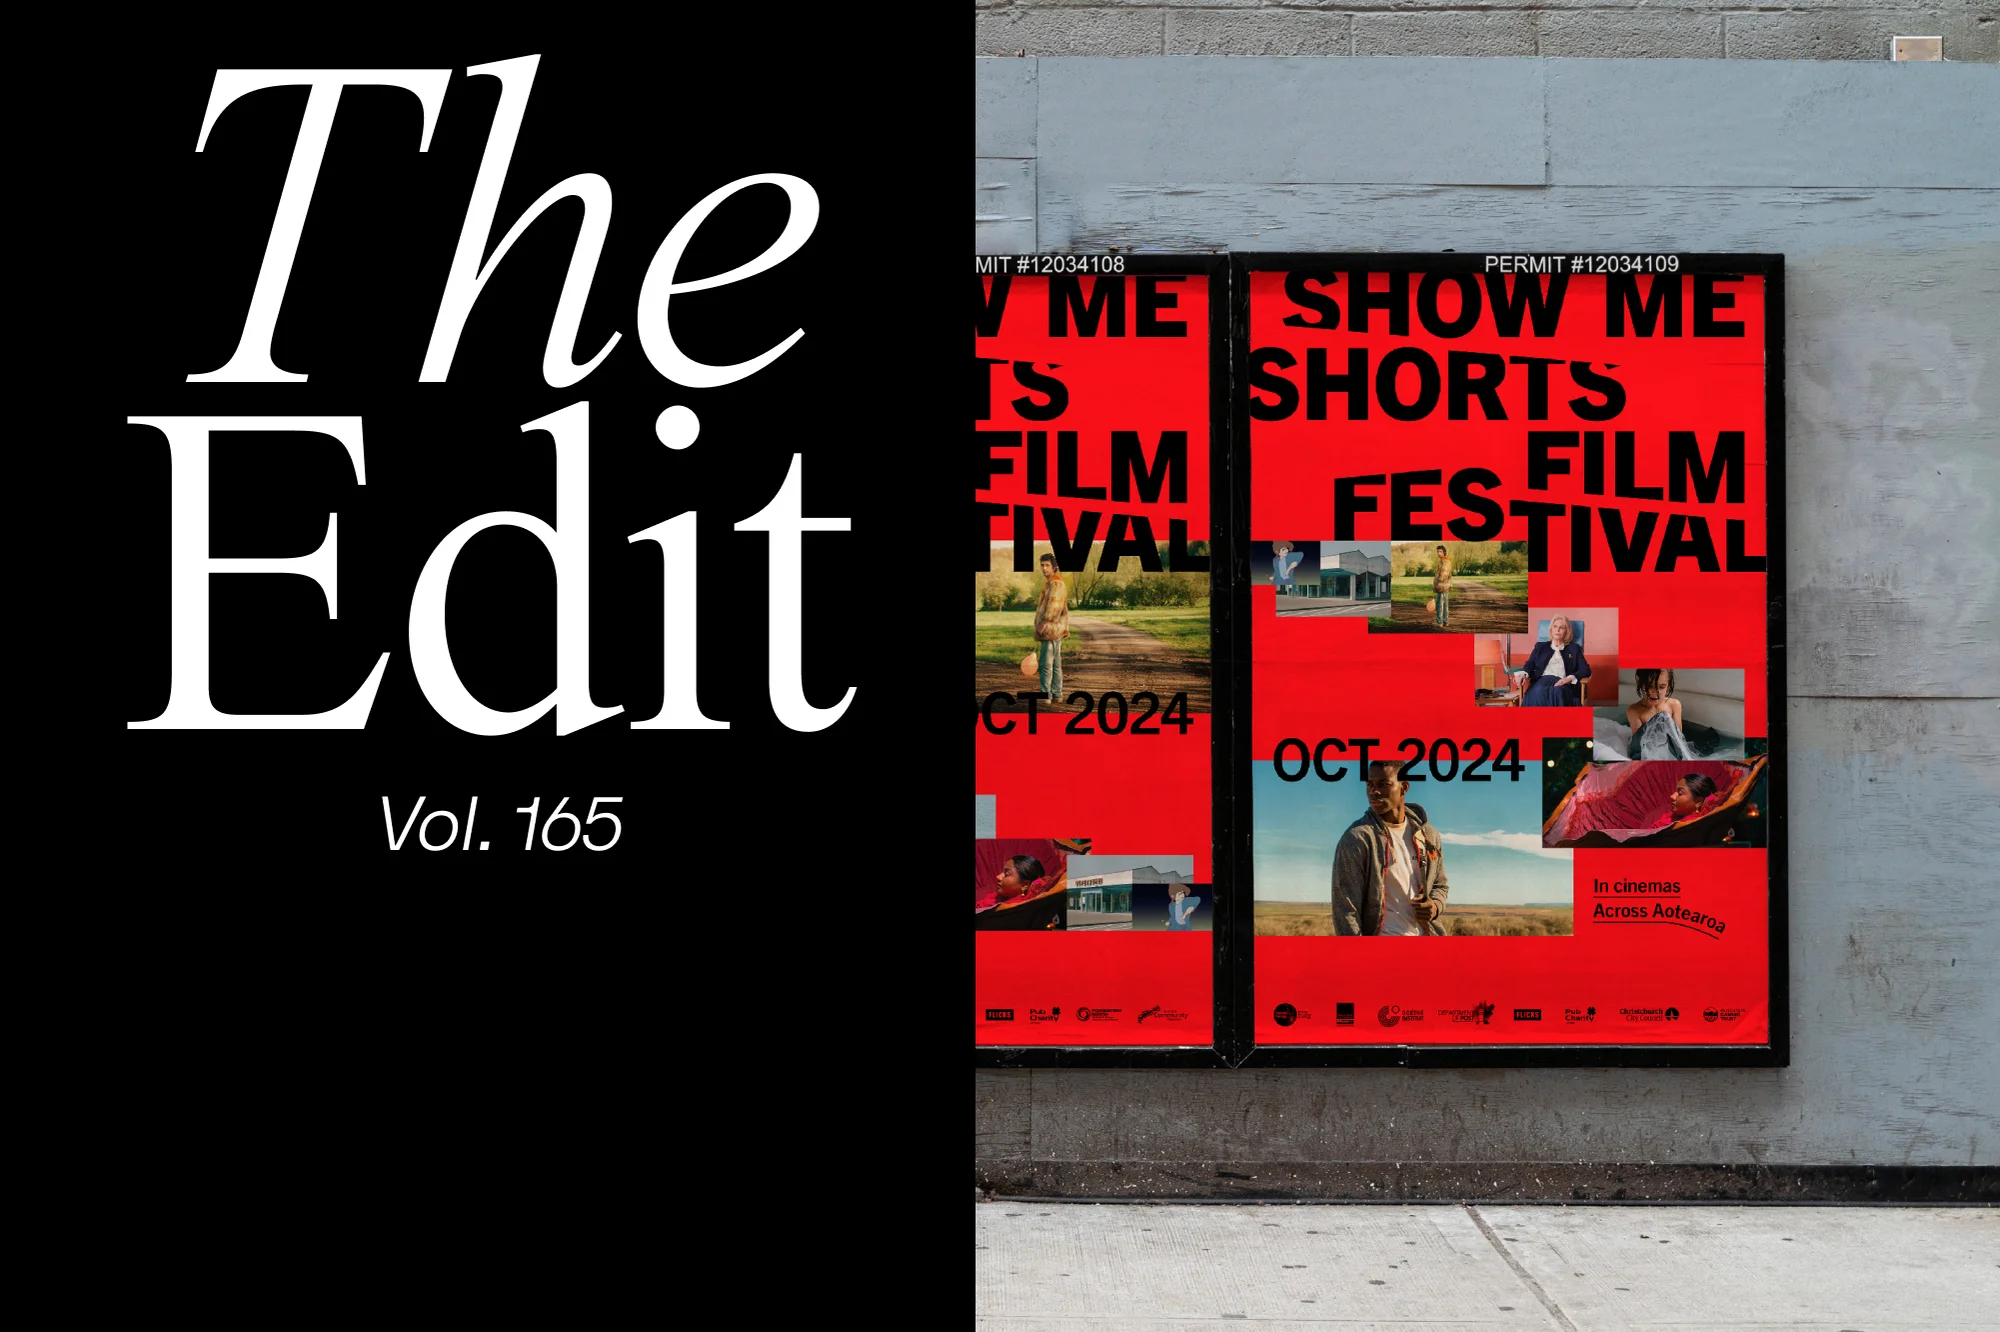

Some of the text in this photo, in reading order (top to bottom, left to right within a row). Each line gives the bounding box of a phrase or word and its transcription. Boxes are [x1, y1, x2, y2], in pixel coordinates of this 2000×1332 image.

[1017, 256, 1125, 273] #12034108
[1485, 255, 1679, 273] PERMIT #12034109
[1048, 275, 1187, 337] ME
[1283, 271, 1745, 339] SHOW ME
[1250, 346, 1627, 422] SHORTS
[975, 431, 1187, 503] FILM
[1528, 431, 1745, 504] FILM
[1065, 691, 1194, 735] 2024
[1273, 738, 1525, 782] OCT 2024
[1594, 879, 1681, 894] In cinemas
[1593, 903, 1727, 934] Across Aotearoa
[988, 1011, 1012, 1019] FLICKS
[1516, 1011, 1539, 1019] FLICKS
[1564, 1014, 1595, 1023] Charity
